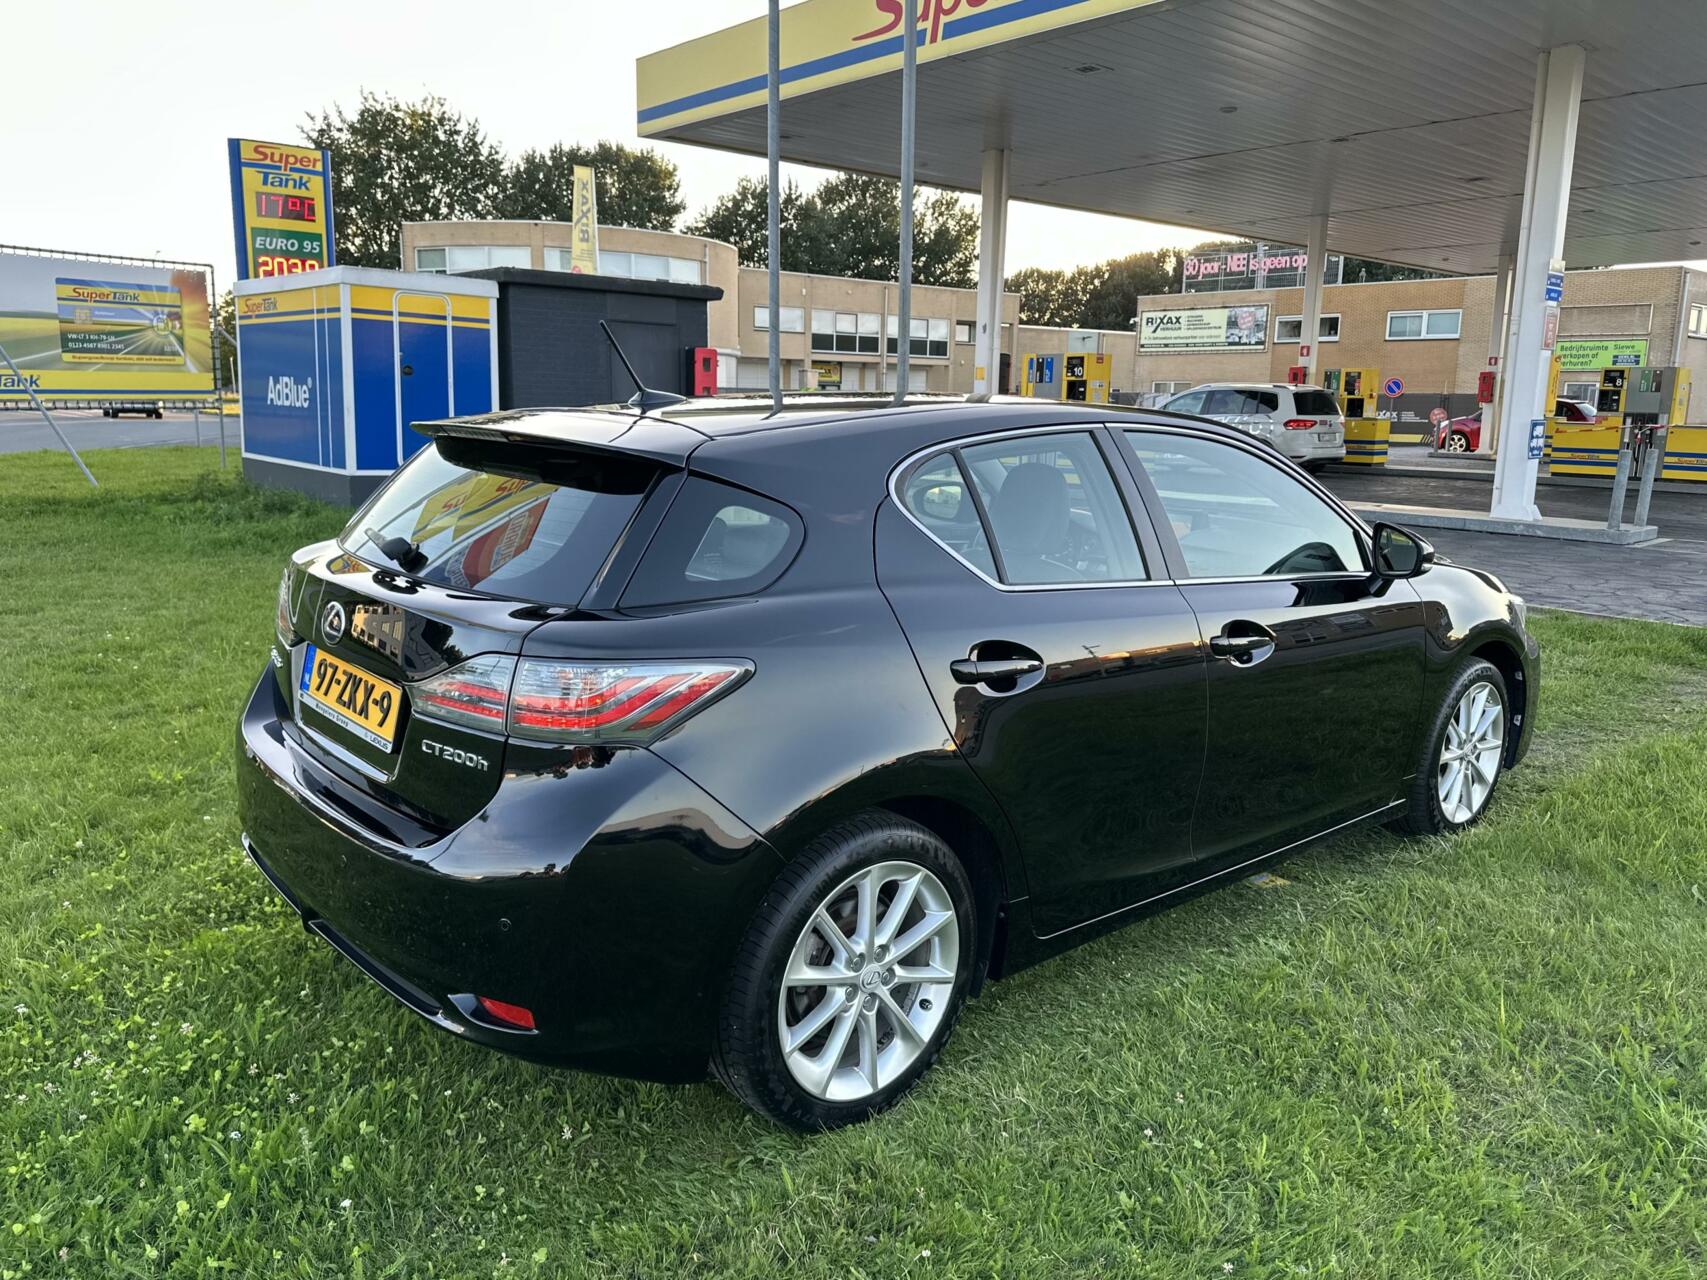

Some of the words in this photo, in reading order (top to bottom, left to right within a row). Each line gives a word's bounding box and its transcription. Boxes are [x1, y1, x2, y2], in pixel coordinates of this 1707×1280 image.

[241, 144, 320, 172] Super
[255, 170, 311, 191] Tank
[255, 236, 299, 251] EURO
[303, 241, 321, 253] 95
[1073, 367, 1083, 376] 10
[1616, 378, 1623, 386] 8
[315, 658, 392, 728] 97-ZKX-9
[421, 739, 488, 772] CT200h
